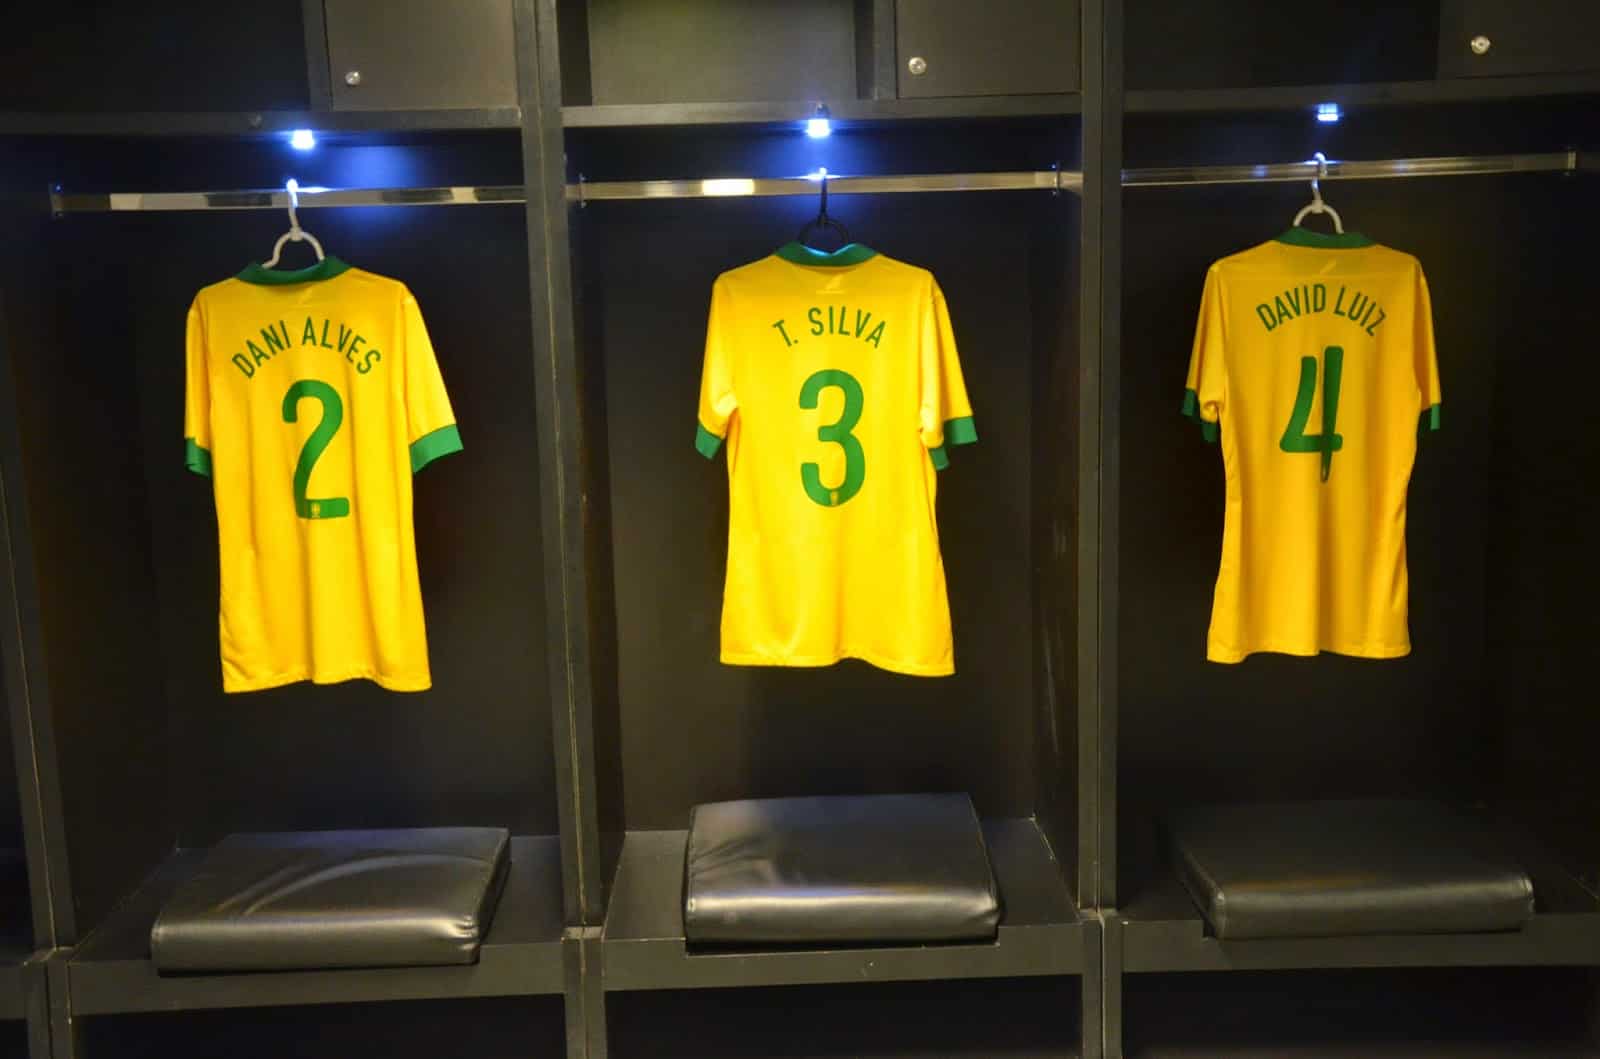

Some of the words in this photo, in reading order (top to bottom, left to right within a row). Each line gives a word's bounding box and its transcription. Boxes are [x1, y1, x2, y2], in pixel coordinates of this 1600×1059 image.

[231, 319, 292, 379] DANI
[301, 315, 381, 375] ALVES
[771, 319, 799, 347] T.
[807, 305, 886, 349] SILVA
[1255, 283, 1327, 332] DAVID
[1332, 285, 1387, 337] LUIZ
[282, 379, 350, 520] 2
[798, 368, 866, 508] 3
[1279, 345, 1344, 484] 4
